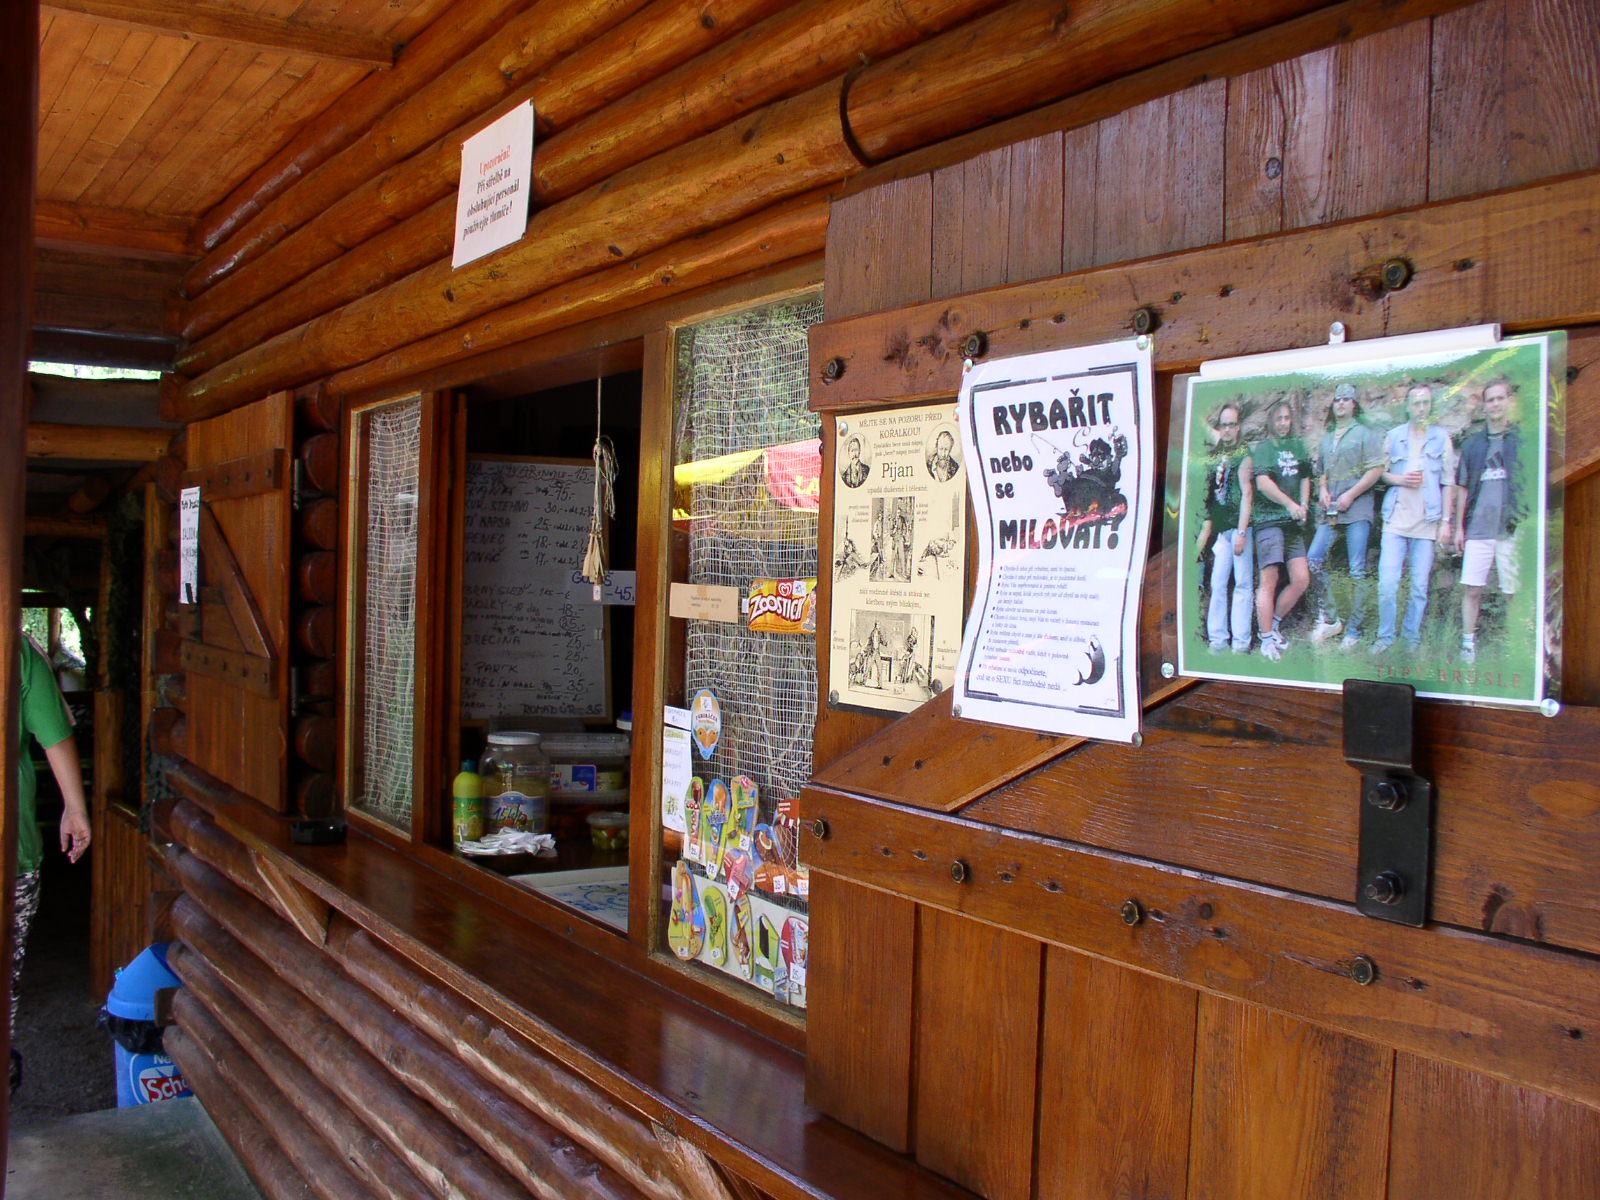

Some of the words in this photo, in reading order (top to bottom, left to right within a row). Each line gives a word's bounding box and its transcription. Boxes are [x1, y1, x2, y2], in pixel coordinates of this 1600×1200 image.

[495, 178, 520, 206] personál
[878, 418, 887, 426] SE
[888, 416, 897, 425] NA
[898, 414, 923, 424] POZORU
[924, 412, 943, 422] PŘED
[992, 388, 1114, 436] RYBAŘIT
[879, 426, 921, 440] KOŘALKOU!
[881, 462, 914, 482] Pijan
[990, 451, 1033, 474] nebo
[995, 482, 1015, 499] se
[572, 570, 614, 587] GUŠ
[749, 593, 807, 623] ZOOSTICK
[996, 674, 1012, 684] SEXU
[1438, 668, 1524, 689] BRUSLE
